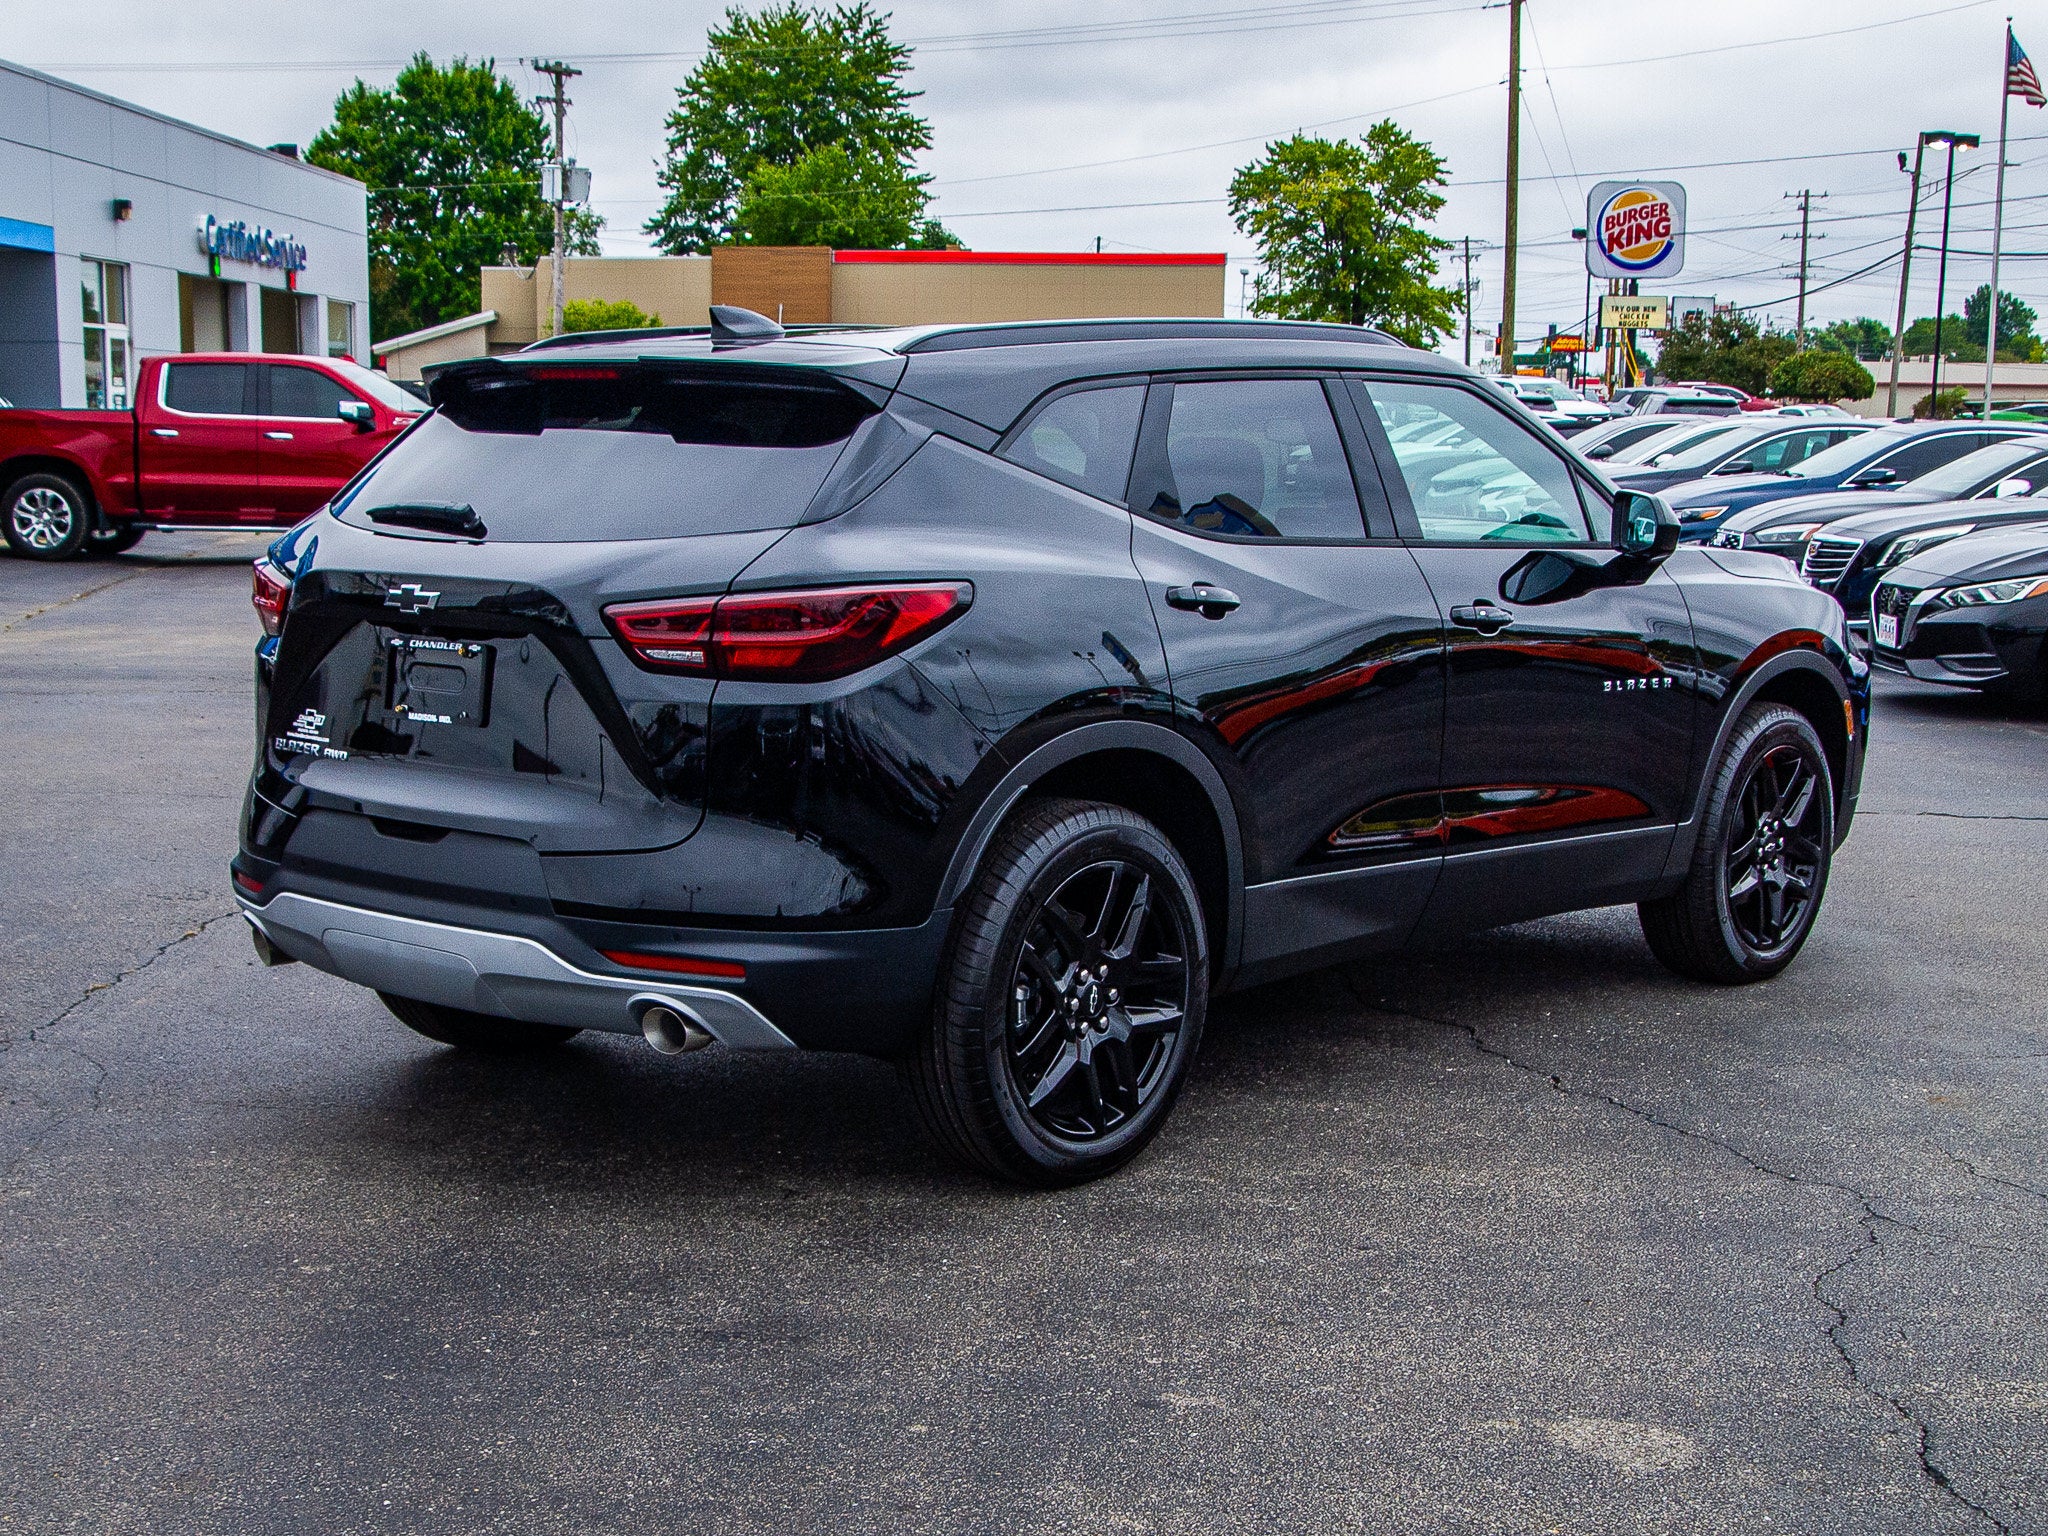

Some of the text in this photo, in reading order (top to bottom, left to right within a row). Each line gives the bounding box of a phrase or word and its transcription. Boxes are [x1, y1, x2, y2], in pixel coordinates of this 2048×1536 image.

[1605, 202, 1669, 233] BURGER
[196, 213, 306, 271] Certified Service
[1607, 216, 1671, 254] KING
[1611, 305, 1657, 313] TRY OUR NEW
[409, 640, 462, 650] CHANDLER
[1603, 677, 1672, 692] BLAZER
[275, 737, 348, 760] BLAZER AWD
